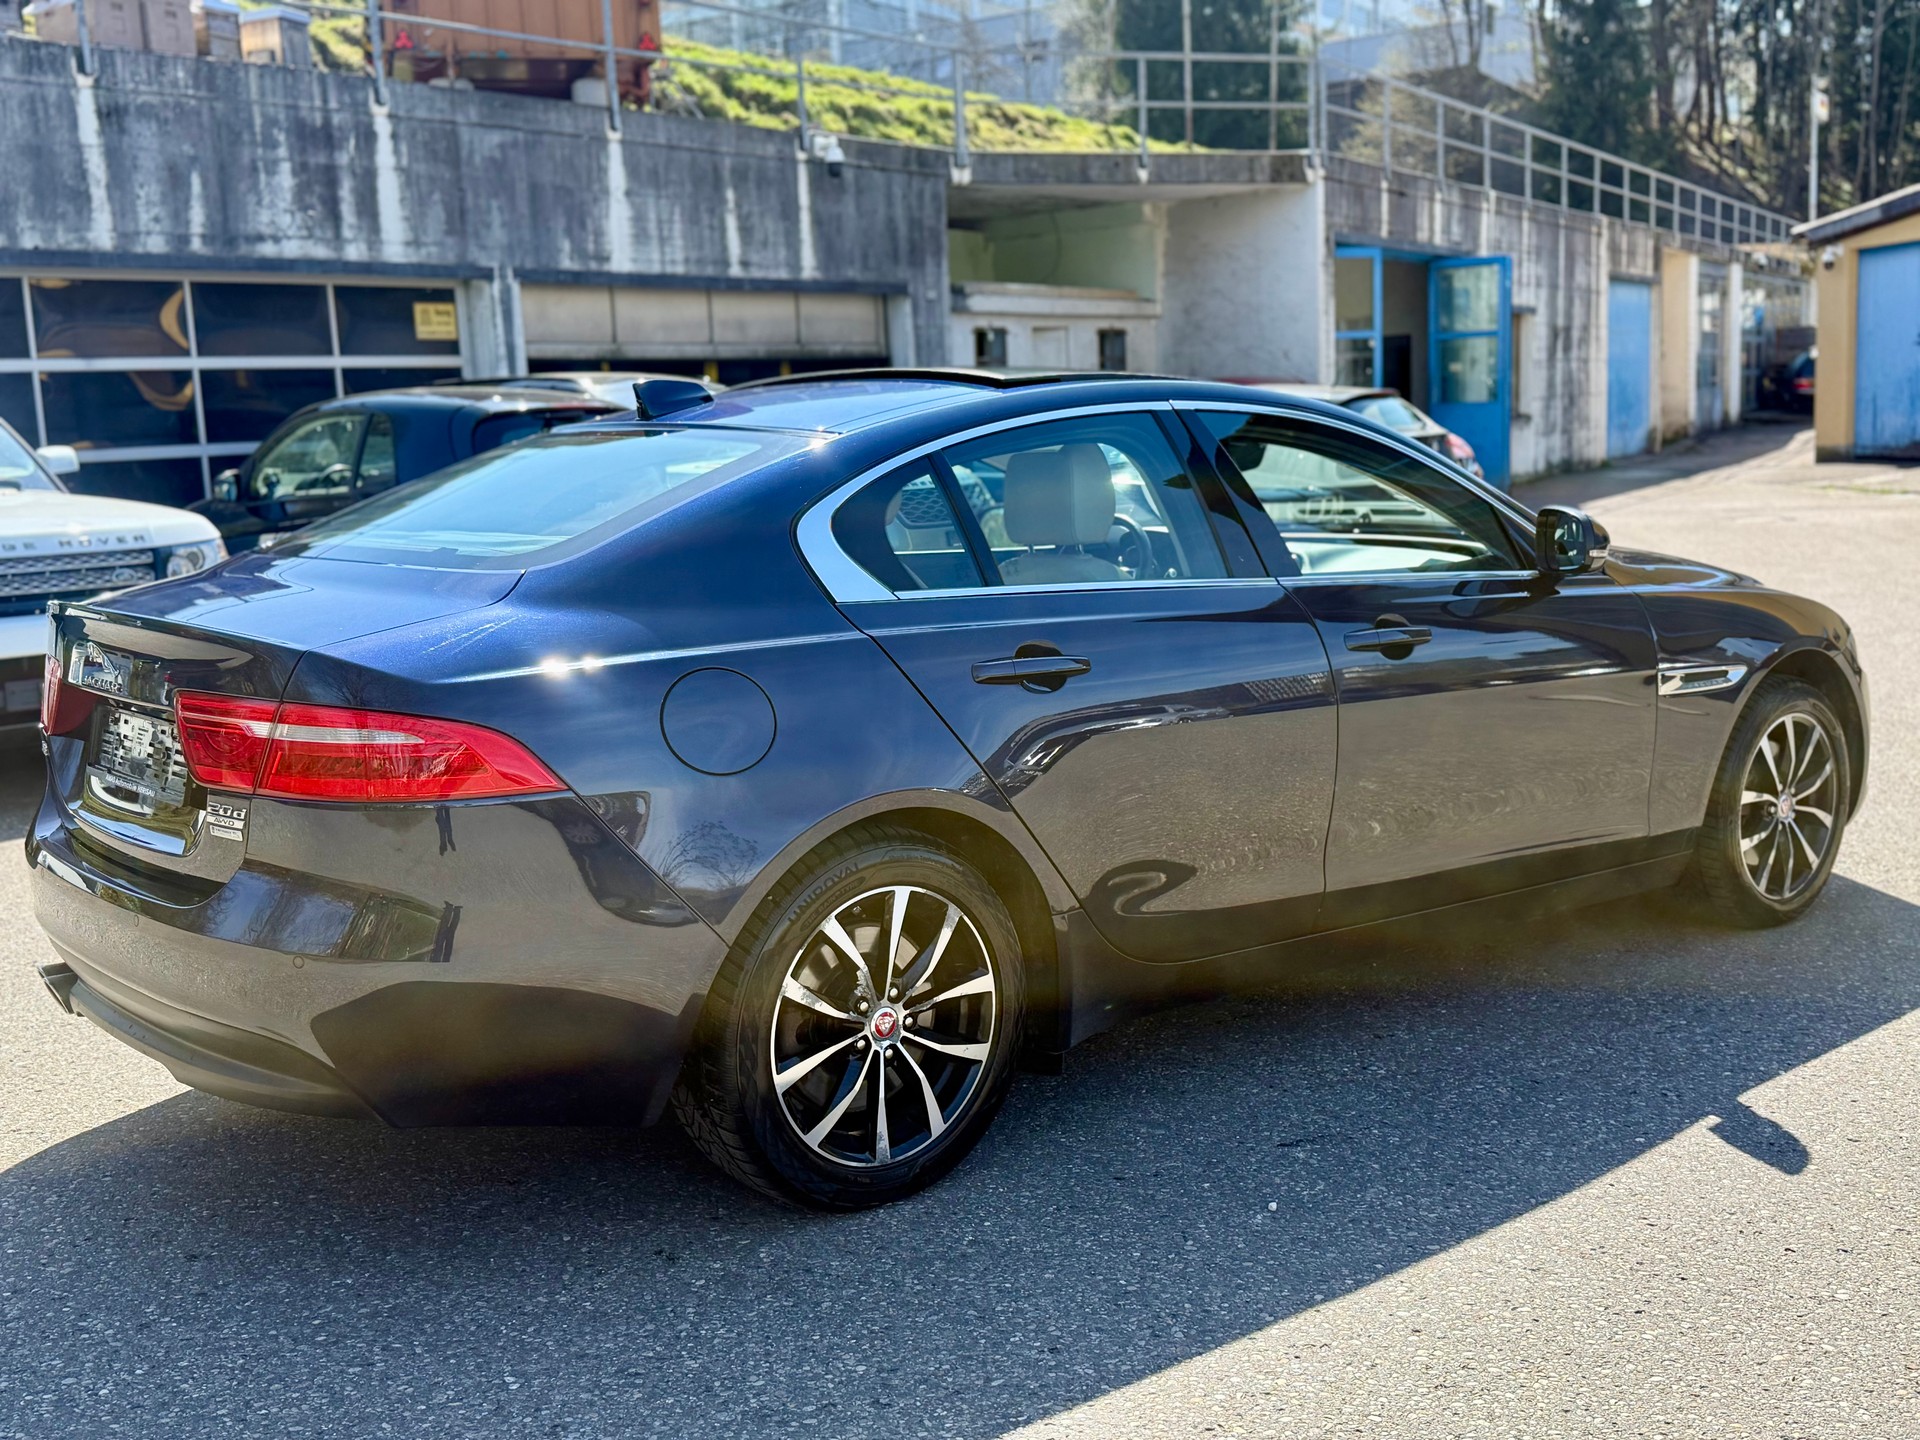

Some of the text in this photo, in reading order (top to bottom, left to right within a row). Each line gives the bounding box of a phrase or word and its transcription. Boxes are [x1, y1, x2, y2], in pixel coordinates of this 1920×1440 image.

[58, 534, 146, 549] ROVER
[83, 675, 123, 693] JAGUAR
[213, 816, 235, 827] AWD
